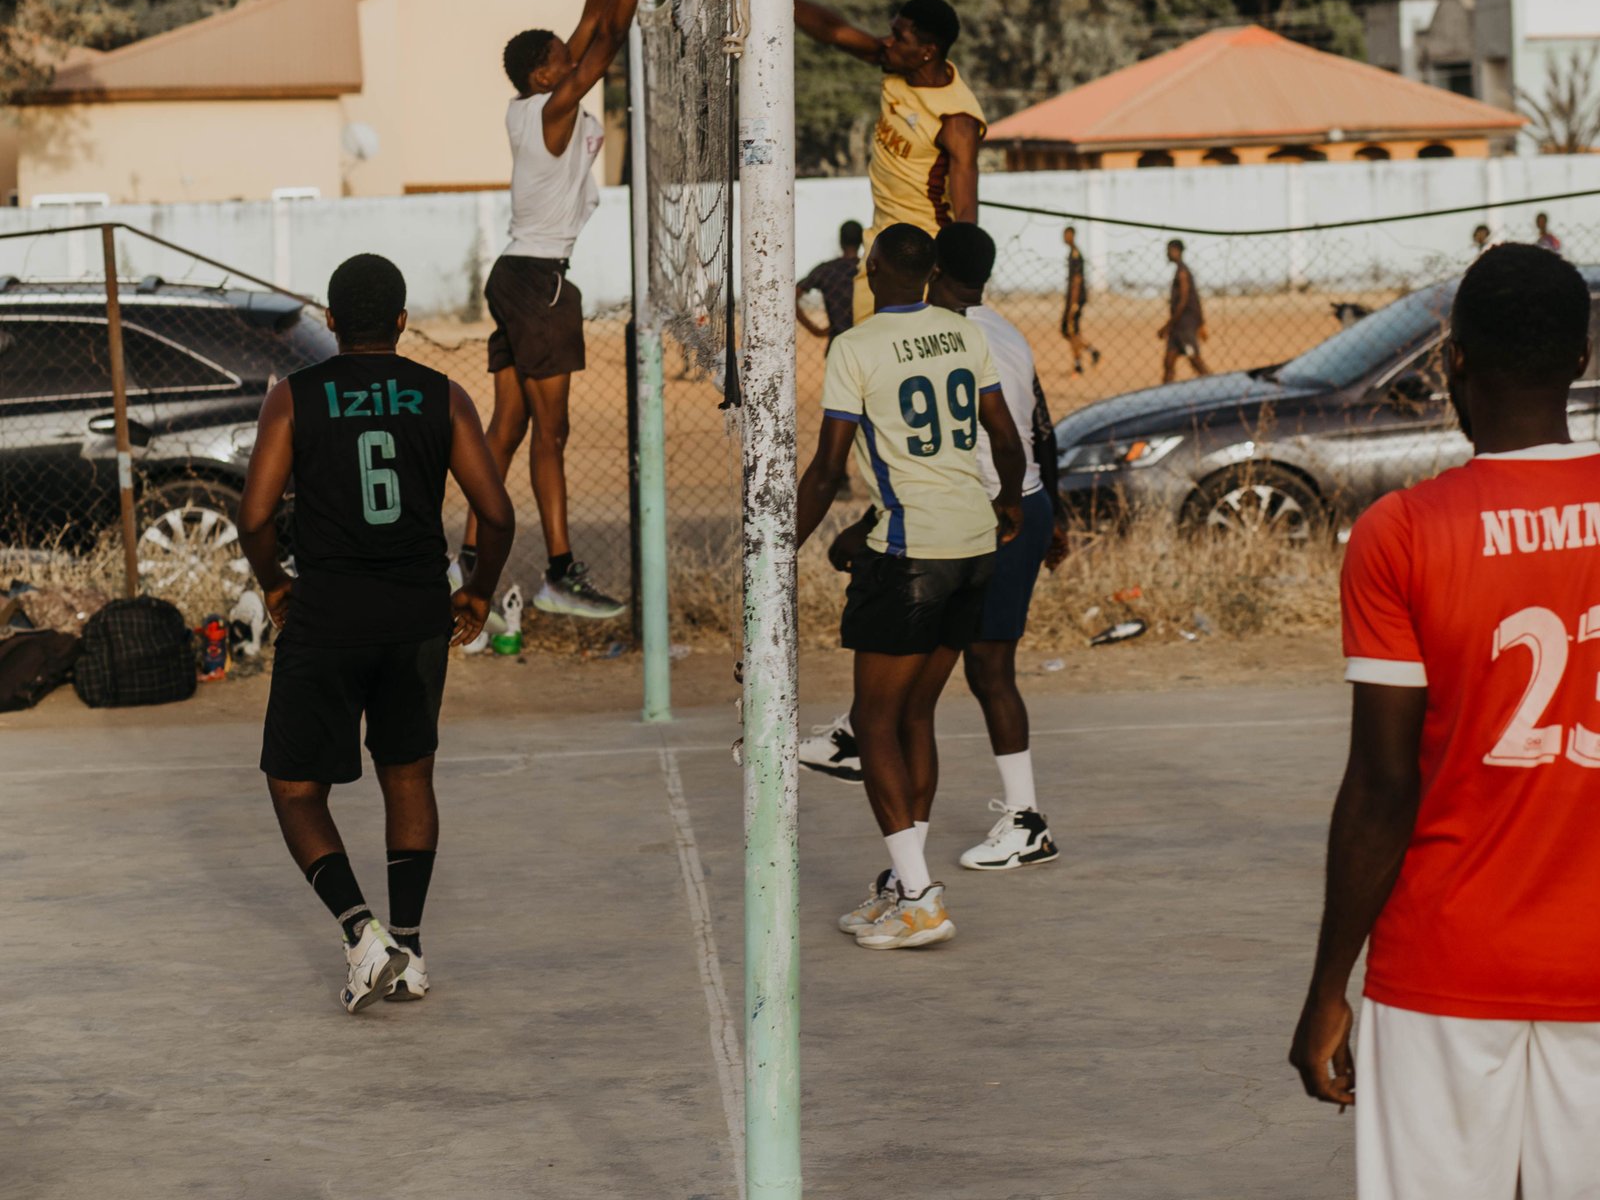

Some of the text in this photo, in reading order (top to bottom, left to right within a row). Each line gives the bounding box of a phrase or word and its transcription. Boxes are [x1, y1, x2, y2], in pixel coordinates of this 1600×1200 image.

[892, 331, 967, 364] I.S SAMSON
[323, 378, 424, 419] Izik
[898, 367, 978, 458] 99
[357, 430, 402, 525] 6
